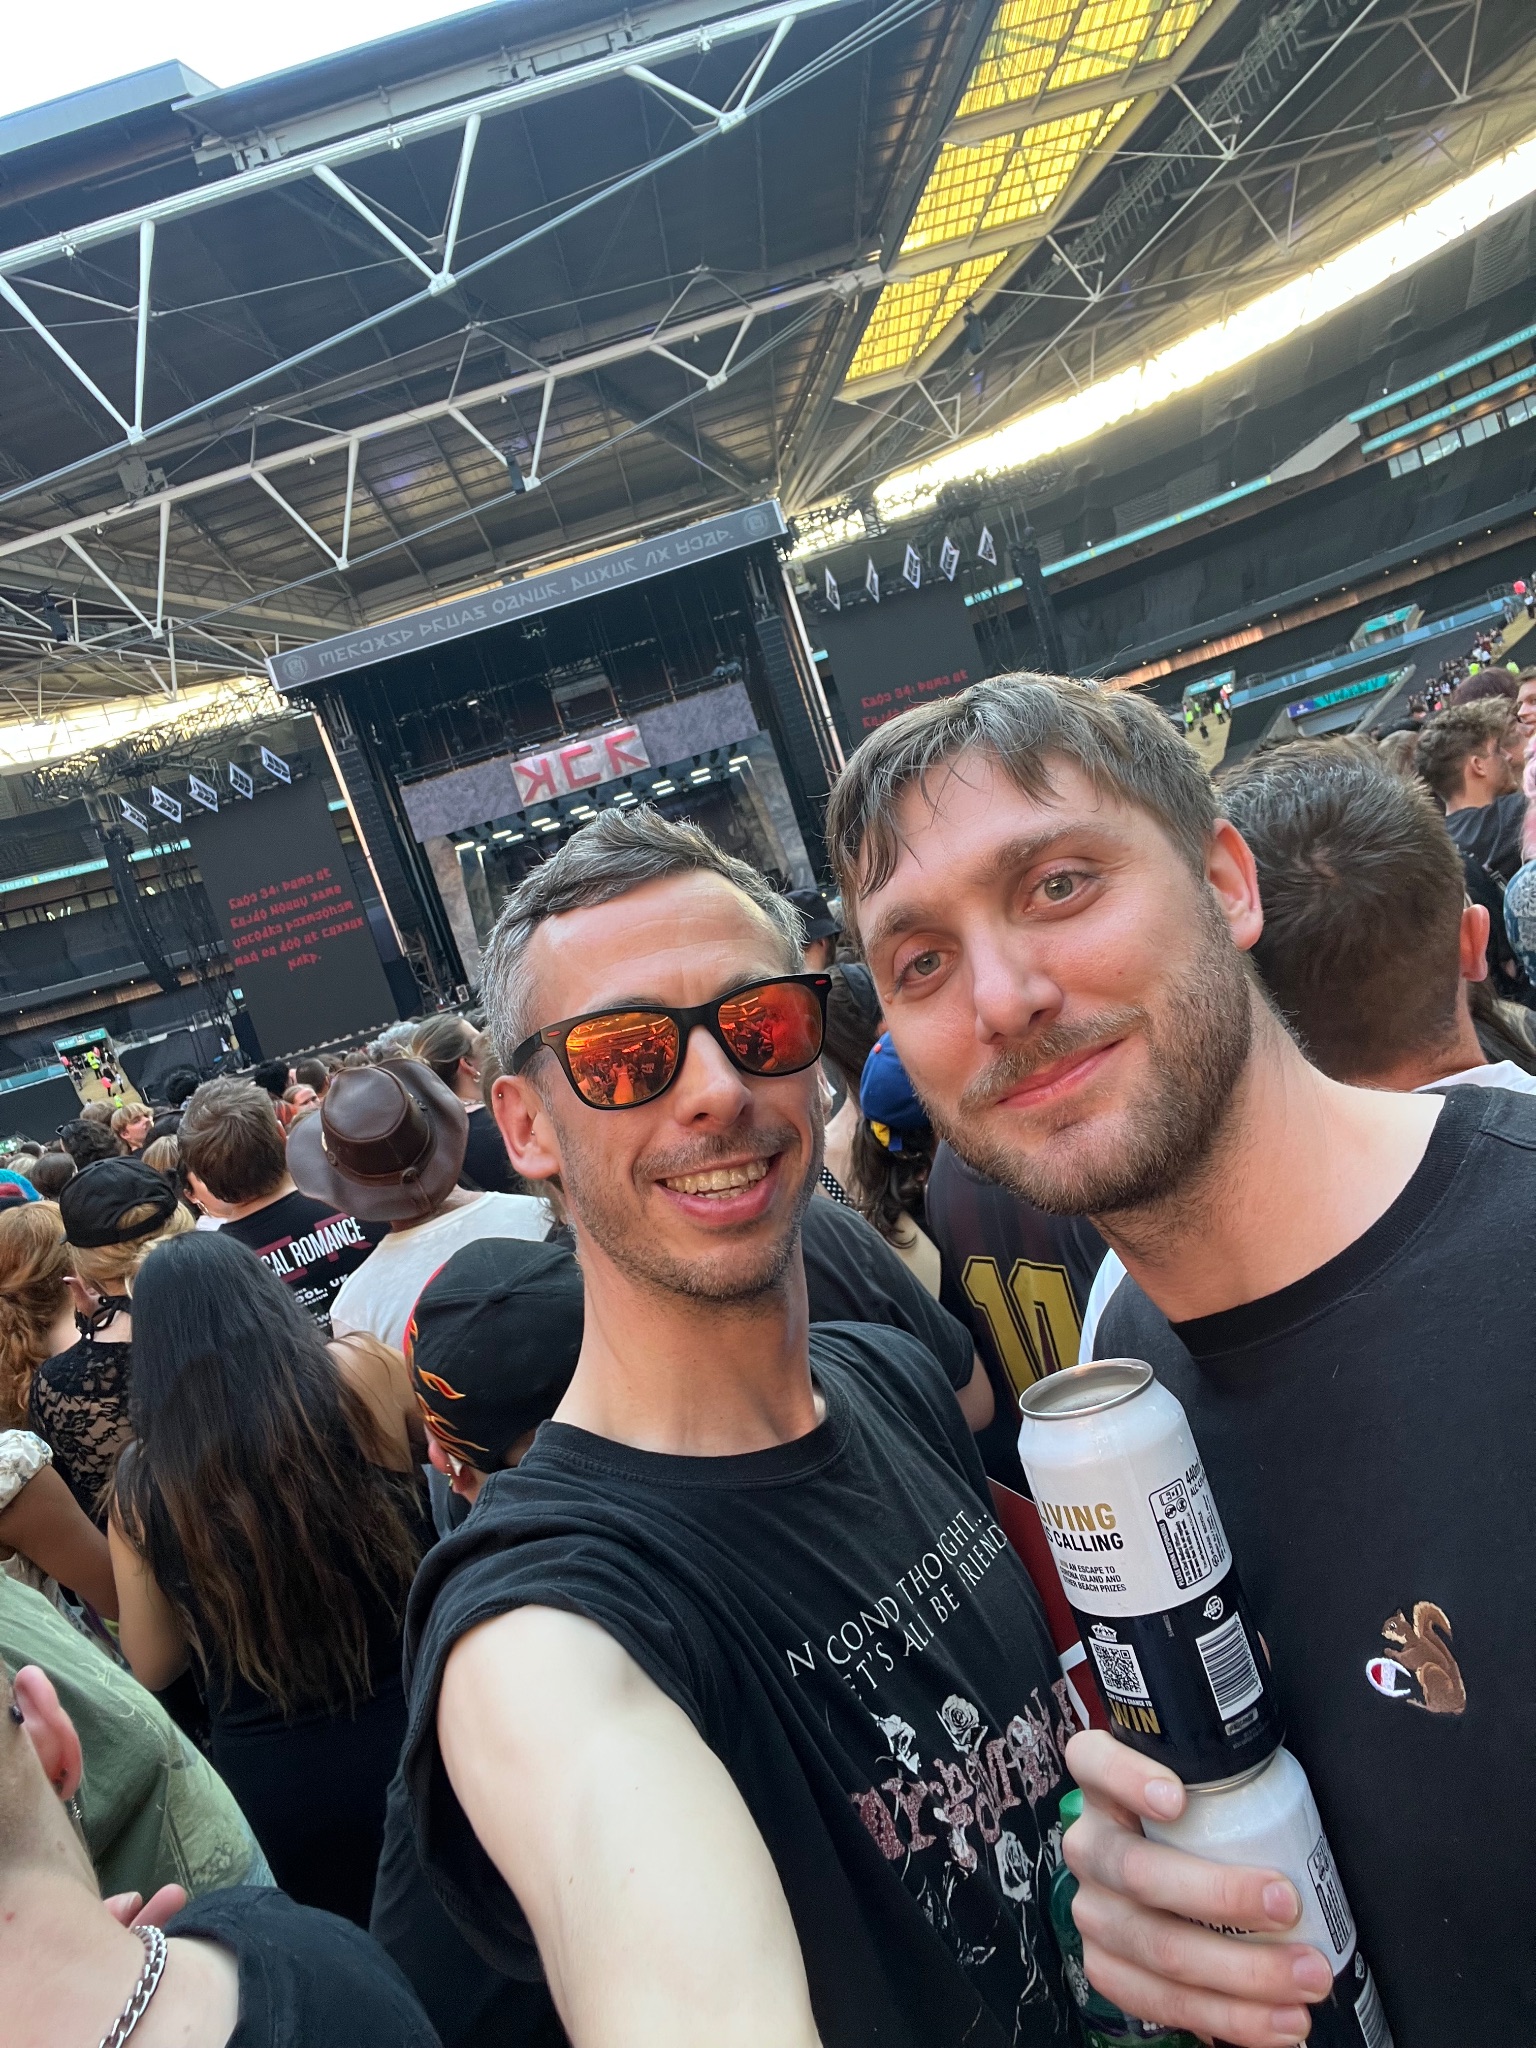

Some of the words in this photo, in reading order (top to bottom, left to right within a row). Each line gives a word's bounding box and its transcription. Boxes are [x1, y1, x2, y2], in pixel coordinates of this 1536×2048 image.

[260, 1249, 295, 1277] CAL
[289, 1216, 365, 1268] ROMANCE
[961, 1255, 1083, 1397] 10
[1034, 1496, 1116, 1531] LIVING
[1053, 1531, 1123, 1552] CALLING
[1069, 1563, 1077, 1571] AN
[1077, 1565, 1104, 1574] ESCAPE
[1105, 1566, 1116, 1574] TO
[1079, 1574, 1104, 1583] ISLAND
[1106, 1575, 1121, 1583] AND
[786, 1640, 815, 1677] N
[827, 1595, 900, 1665] COND
[896, 1510, 988, 1604] THOGHT...
[929, 1583, 960, 1624] BE
[1078, 1581, 1099, 1592] BEACH
[1100, 1584, 1127, 1592] PRIZES
[1108, 1698, 1161, 1734] WIN
